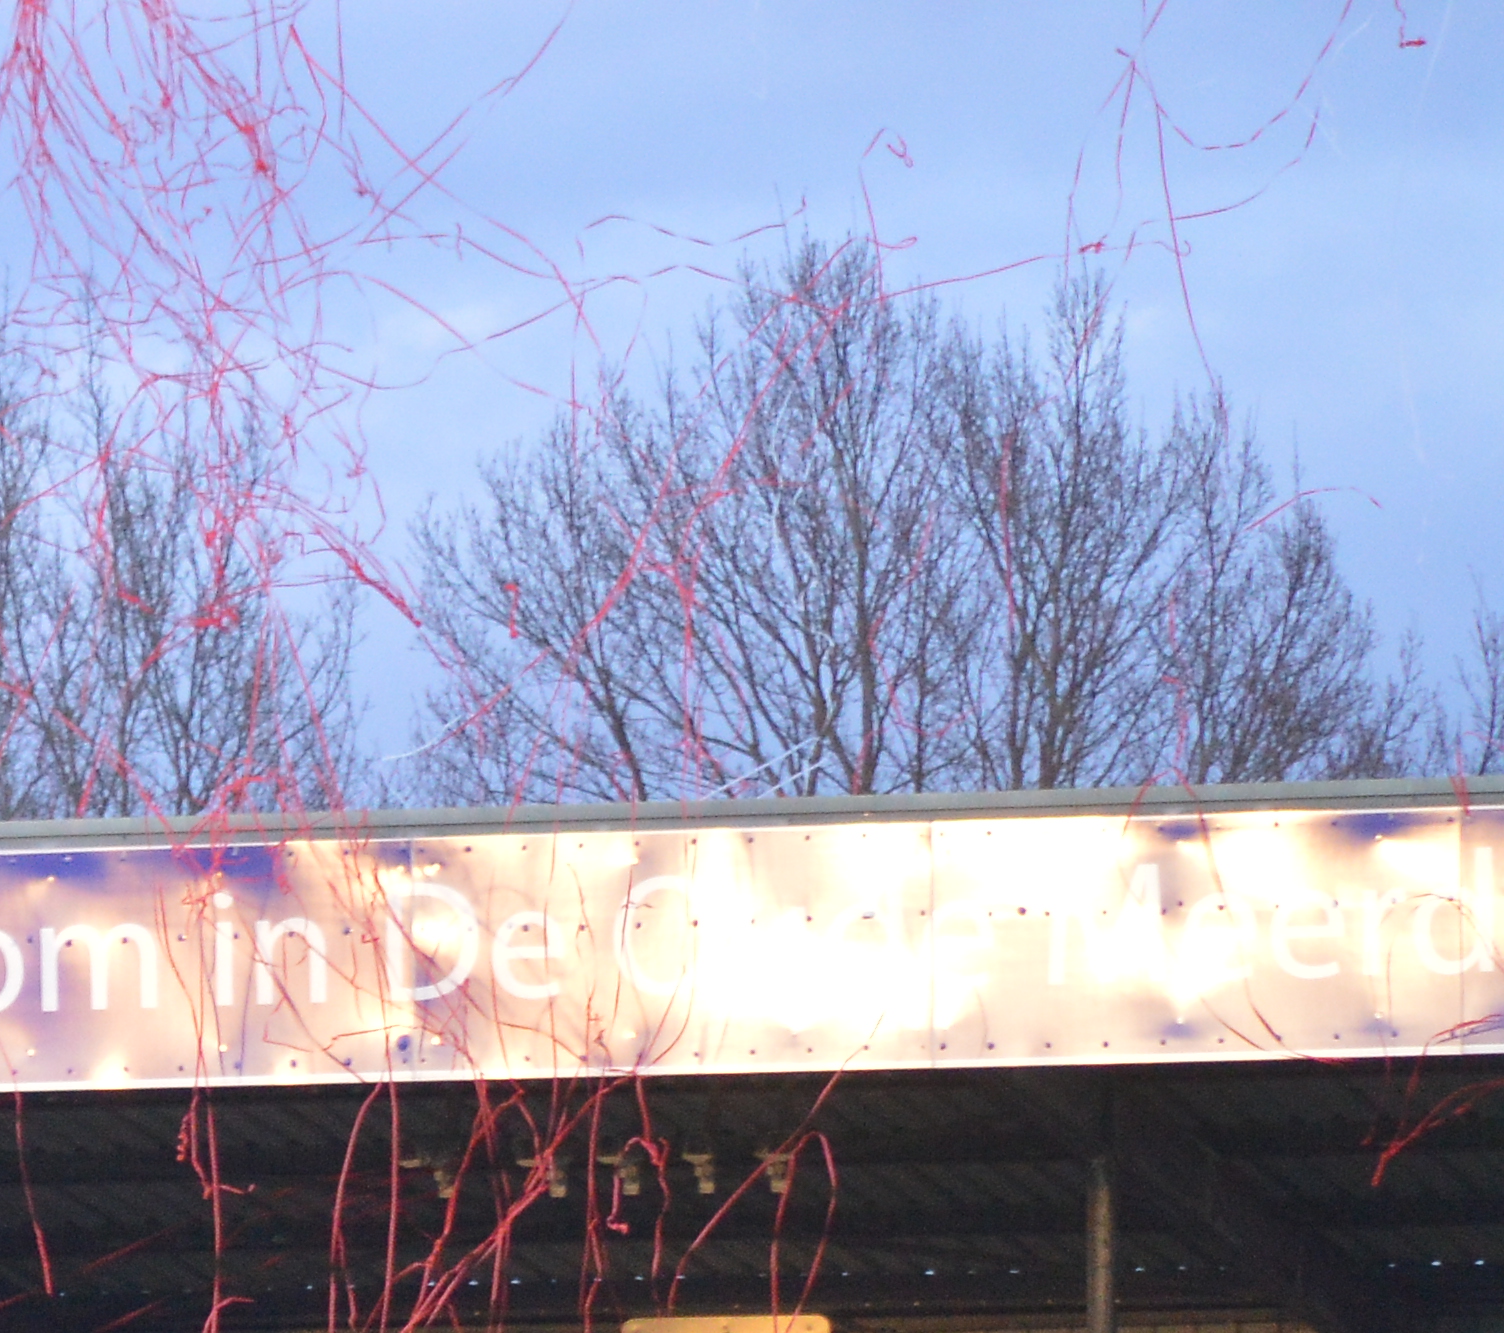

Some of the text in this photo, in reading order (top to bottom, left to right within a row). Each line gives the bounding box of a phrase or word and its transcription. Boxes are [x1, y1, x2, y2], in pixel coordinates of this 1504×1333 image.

[212, 888, 332, 1008] in
[389, 885, 568, 1002] De
[615, 868, 994, 995] Ode
